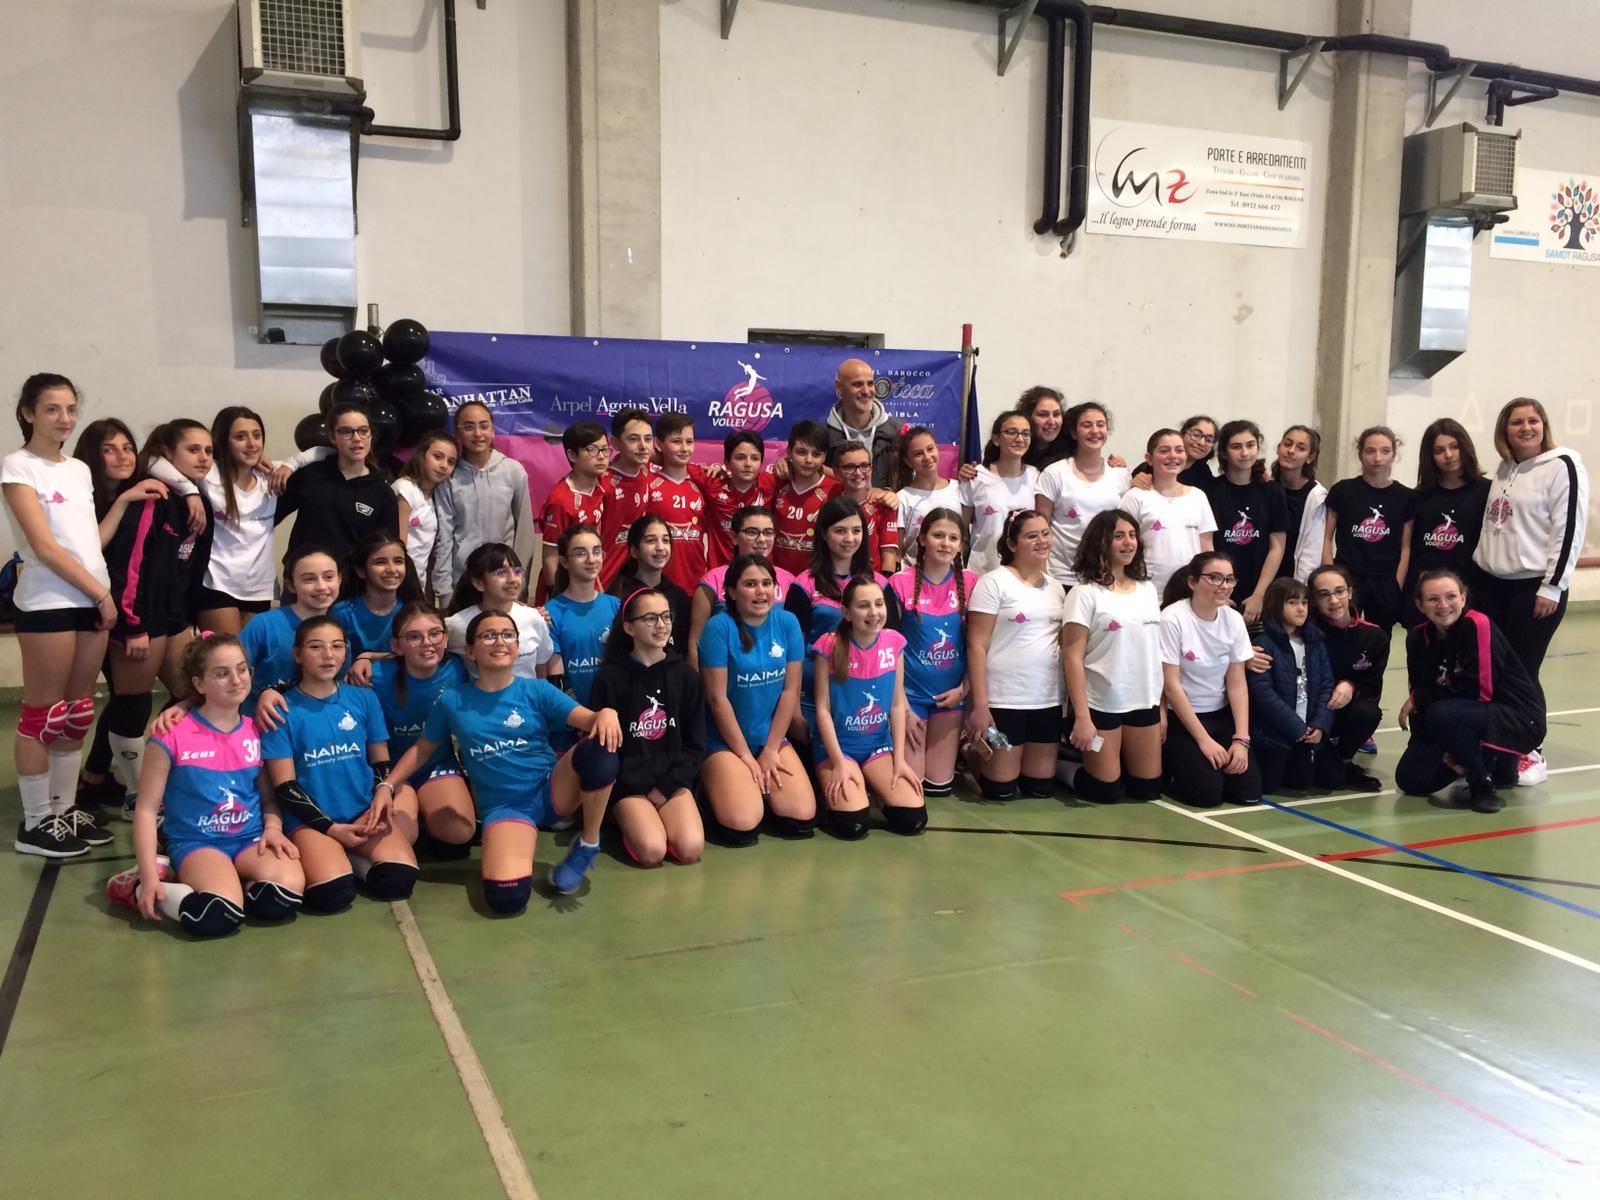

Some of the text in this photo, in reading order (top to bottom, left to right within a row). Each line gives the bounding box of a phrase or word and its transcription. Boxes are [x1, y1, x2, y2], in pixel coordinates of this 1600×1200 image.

[1207, 147, 1306, 170] PORTE E ARREDAMENTI
[1110, 212, 1134, 230] legno
[1133, 216, 1167, 231] prende
[1166, 217, 1197, 233] forma
[1545, 249, 1570, 260] SAMOT
[550, 395, 592, 416] Arpel
[649, 397, 687, 414] Vella
[708, 401, 783, 418] RAGUSA
[712, 418, 747, 427] VOLLEY
[634, 492, 640, 507] 9
[672, 495, 686, 509] 21
[787, 506, 803, 520] 20
[1224, 530, 1260, 538] RAGUSA
[1351, 525, 1390, 536] RAGUSA
[1424, 533, 1464, 543] RAGUSA
[568, 656, 602, 668] NAI
[878, 647, 895, 669] 25
[737, 667, 786, 682] NAIMA
[629, 717, 676, 732] RAGUSA
[845, 711, 888, 726] RAGUSA
[304, 742, 361, 761] NAIMA
[470, 737, 528, 757] NAIMA
[181, 751, 216, 760] Zeus
